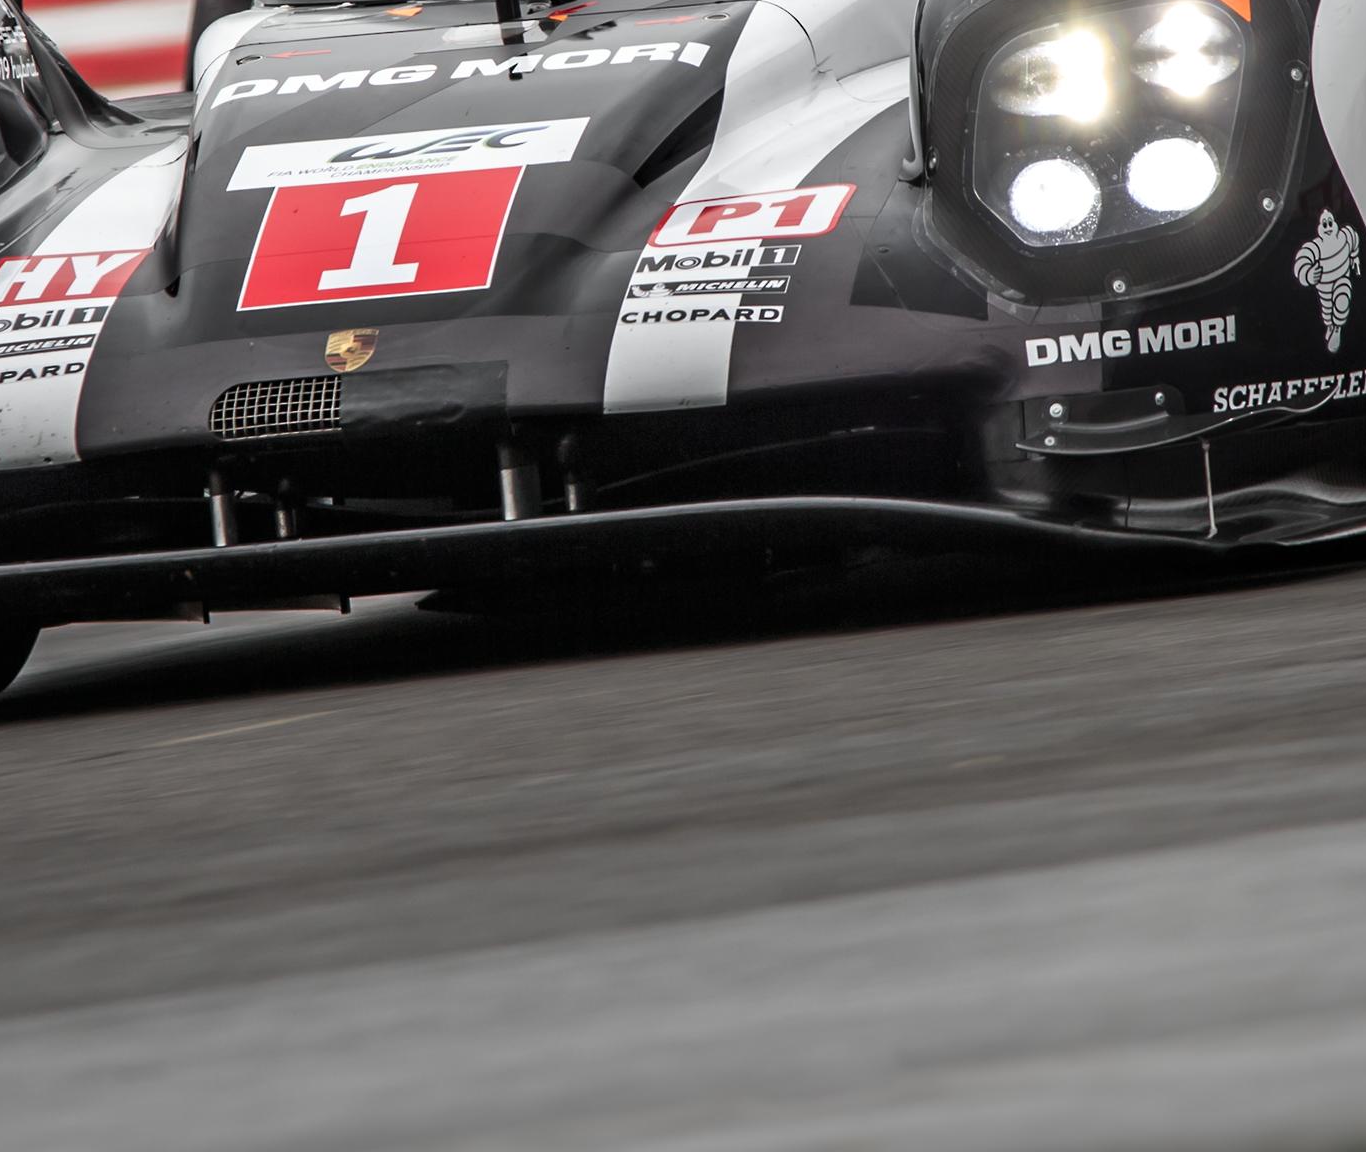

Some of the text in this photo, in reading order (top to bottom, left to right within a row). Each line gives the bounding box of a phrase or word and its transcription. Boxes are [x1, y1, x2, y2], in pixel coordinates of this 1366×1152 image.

[210, 41, 712, 110] DMG MORI
[327, 125, 552, 164] WEC
[298, 164, 355, 176] WORLD
[687, 193, 817, 236] P1
[316, 183, 419, 291] 1
[636, 248, 755, 274] Mobil
[674, 278, 787, 292] MICHELIN
[621, 307, 781, 325] CHOPARD
[1025, 315, 1236, 367] DMG MORI
